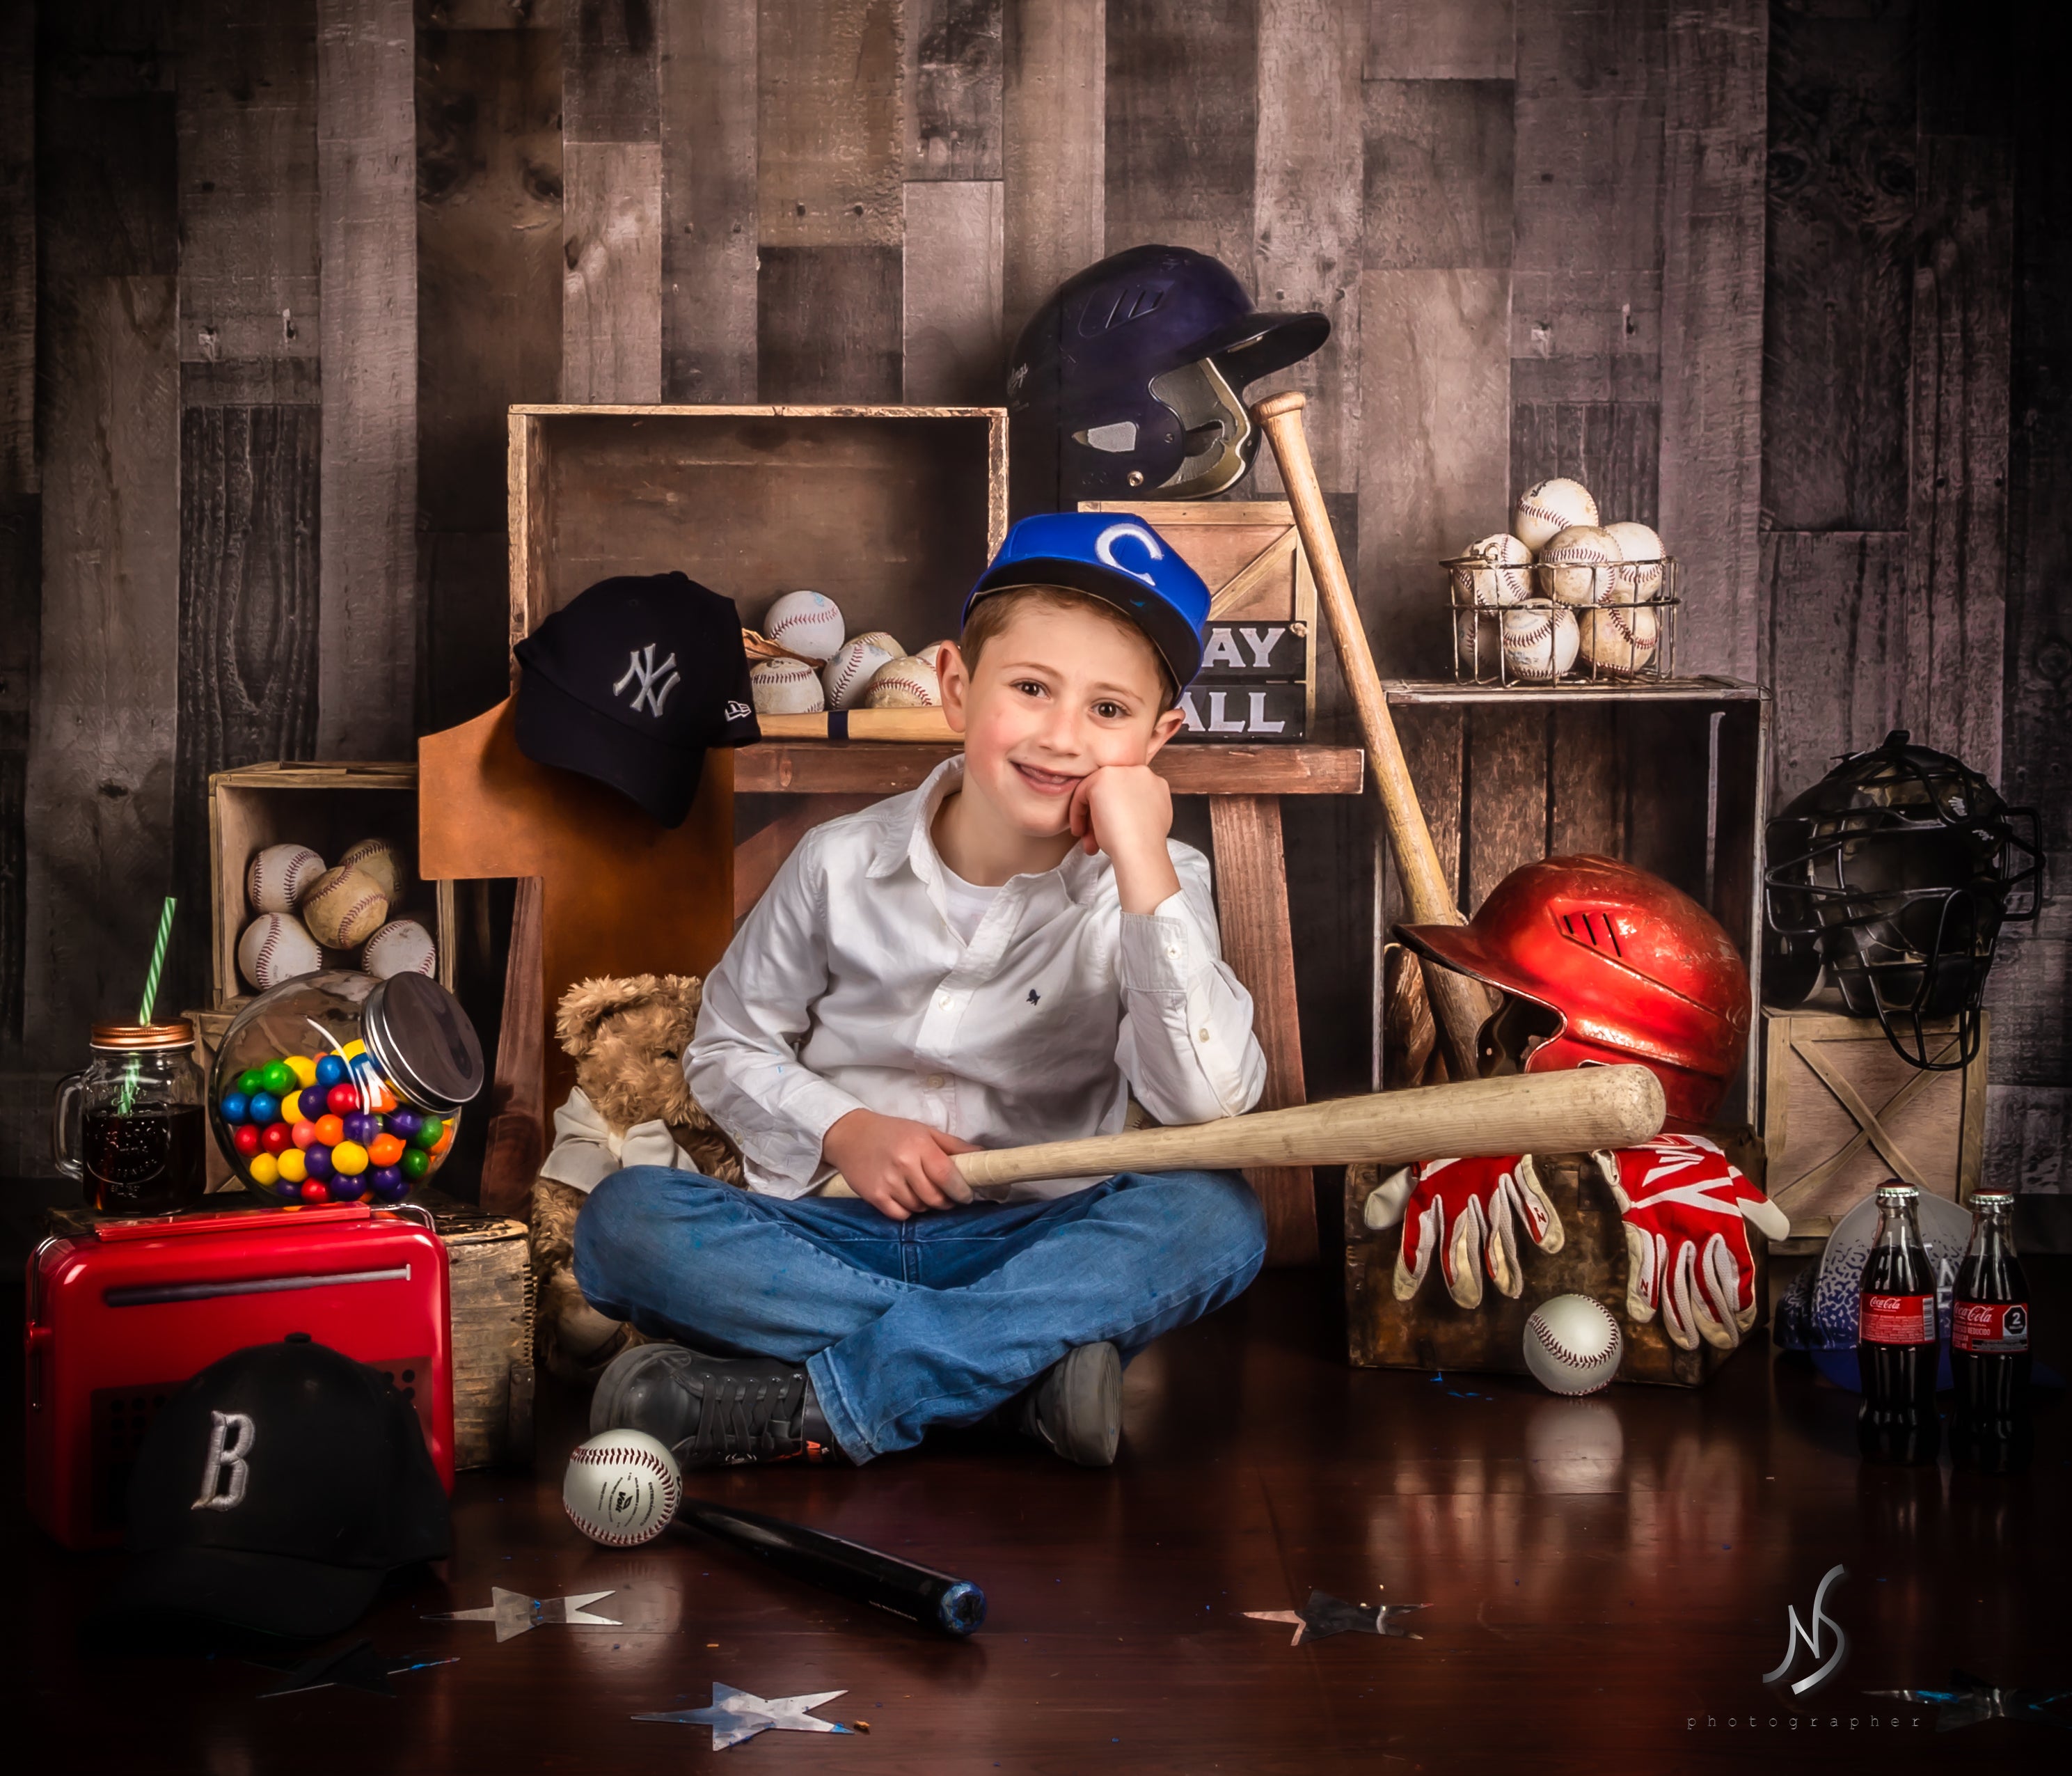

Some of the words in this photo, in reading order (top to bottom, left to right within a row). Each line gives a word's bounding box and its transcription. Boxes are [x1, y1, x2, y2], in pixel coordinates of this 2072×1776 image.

[1094, 522, 1164, 587] C
[1201, 627, 1286, 668] AY
[612, 643, 681, 718] NY
[1175, 691, 1286, 733] ALL
[2011, 1312, 2021, 1325] 2
[190, 1409, 257, 1512] B
